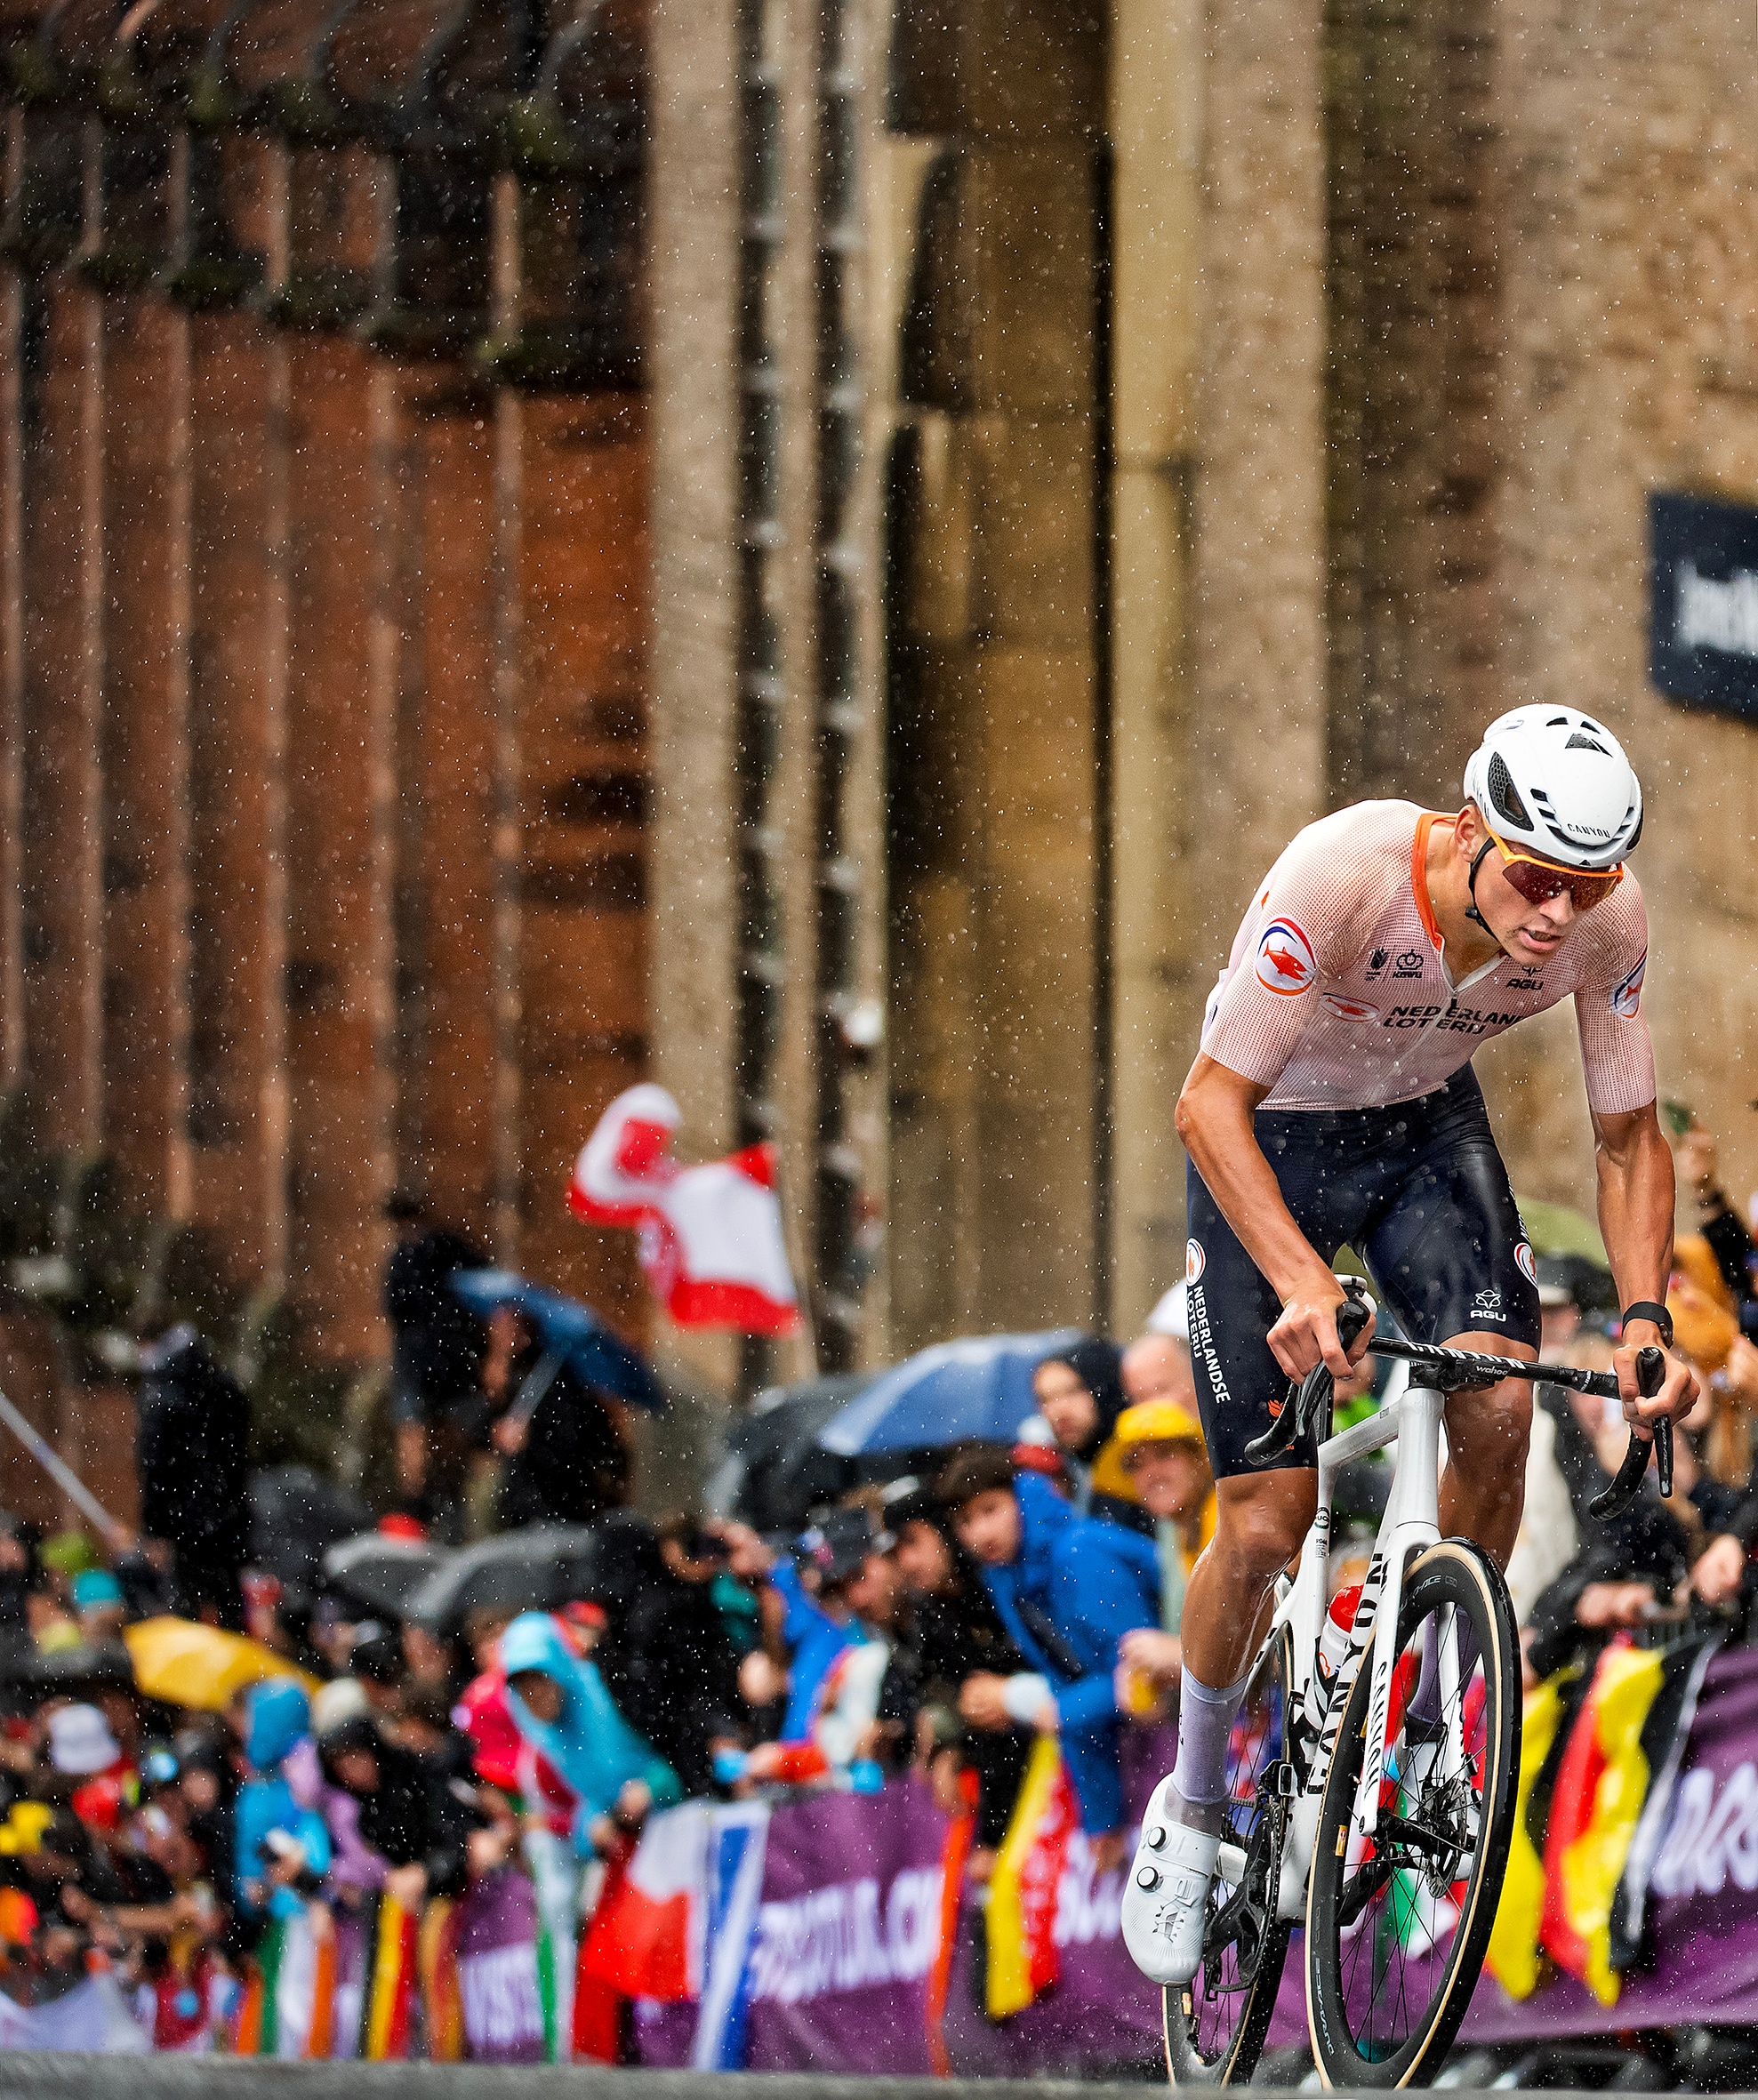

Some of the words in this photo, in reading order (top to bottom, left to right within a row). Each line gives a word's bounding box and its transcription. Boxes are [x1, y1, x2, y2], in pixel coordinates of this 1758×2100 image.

[1567, 823, 1611, 839] CANYON
[1506, 978, 1545, 990] AGU
[1383, 1017, 1486, 1035] LOTERIJ
[1186, 1289, 1203, 1359] LOTERIJ
[1470, 1310, 1507, 1323] AGU
[1193, 1285, 1232, 1404] NEDERLANDSE
[1475, 1365, 1509, 1376] wahoo
